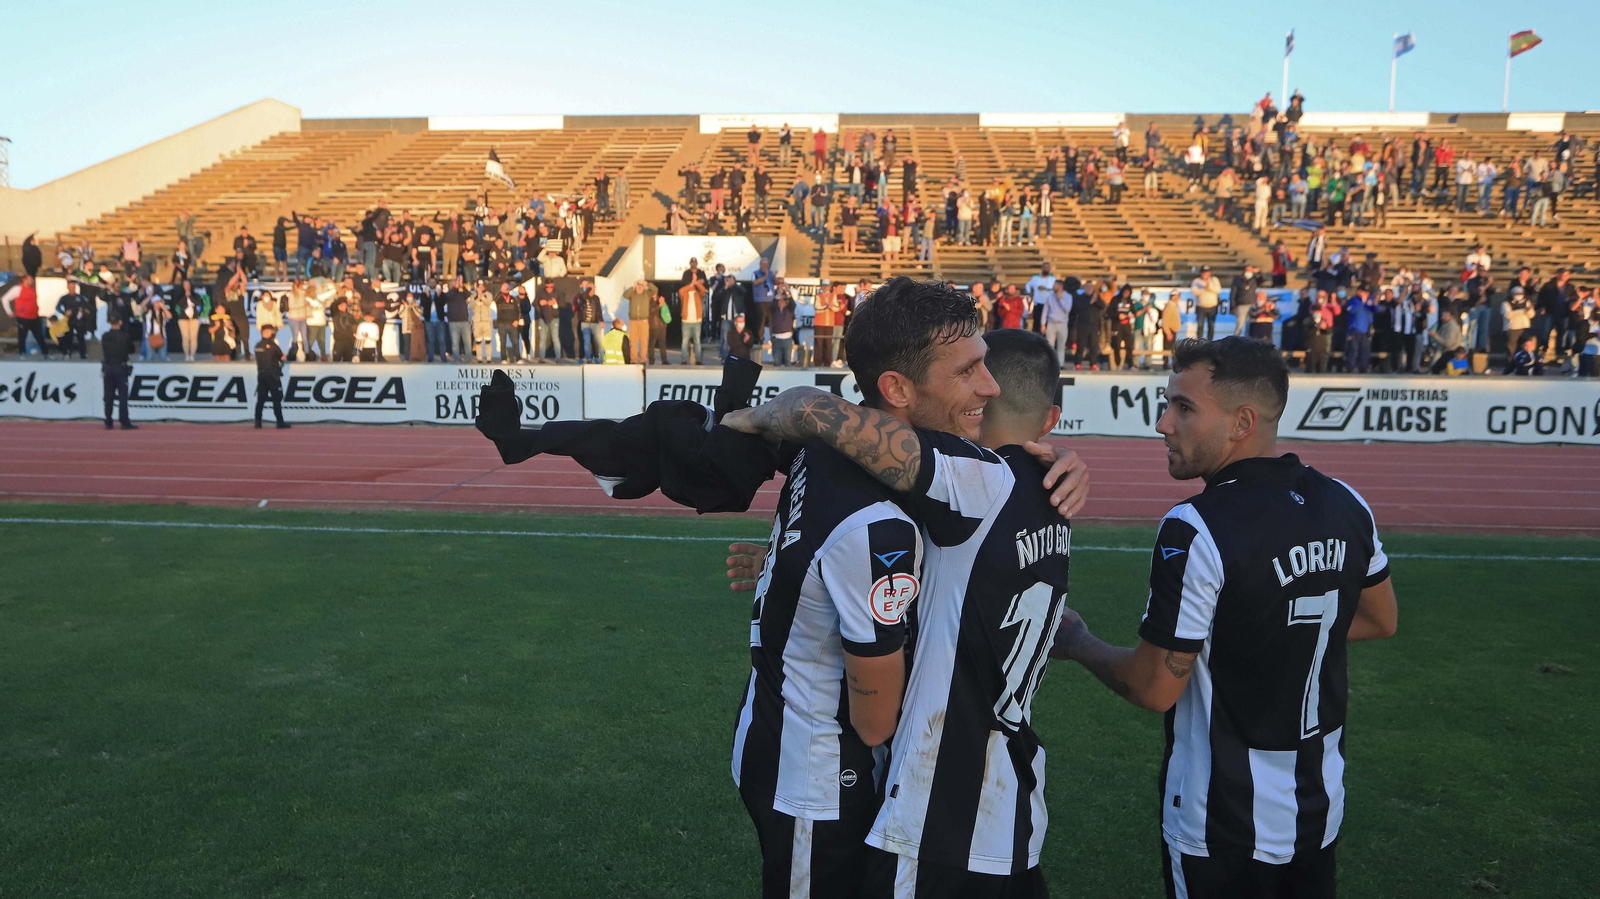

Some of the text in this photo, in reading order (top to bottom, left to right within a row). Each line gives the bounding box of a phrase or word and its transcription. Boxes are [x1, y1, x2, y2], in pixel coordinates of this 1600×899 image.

[409, 283, 449, 294] ULTS
[457, 368, 537, 380] MUEES Y
[129, 374, 248, 402] EGEA
[282, 375, 408, 404] EGEA
[1366, 388, 1449, 401] INDUSTRIAS
[434, 394, 560, 421] BARSO
[1363, 405, 1448, 432] LACSE
[1487, 405, 1587, 436] GPON
[1272, 538, 1347, 588] LOREN
[1286, 588, 1340, 741] 7
